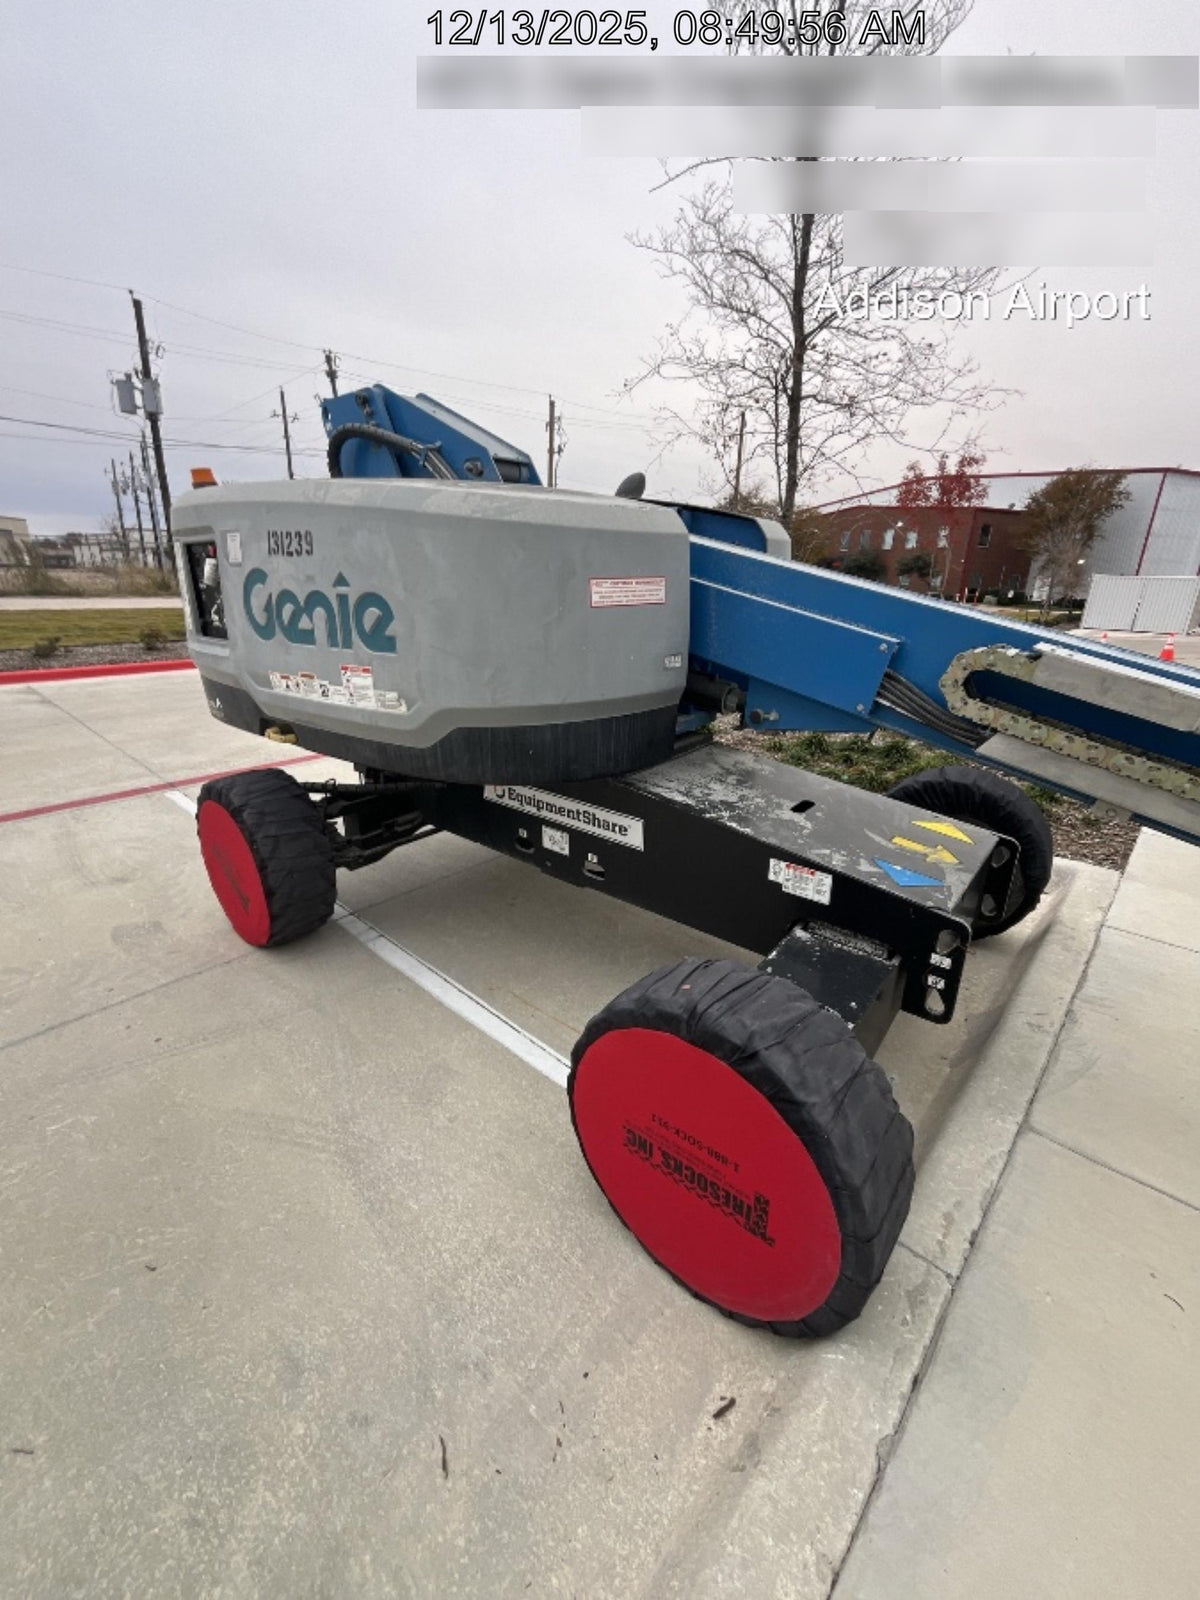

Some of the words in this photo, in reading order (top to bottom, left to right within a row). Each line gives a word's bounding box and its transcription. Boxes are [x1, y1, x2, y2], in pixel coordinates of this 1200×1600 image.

[267, 529, 314, 557] 131239
[243, 567, 398, 653] Genie
[507, 787, 629, 837] EquipmentShare
